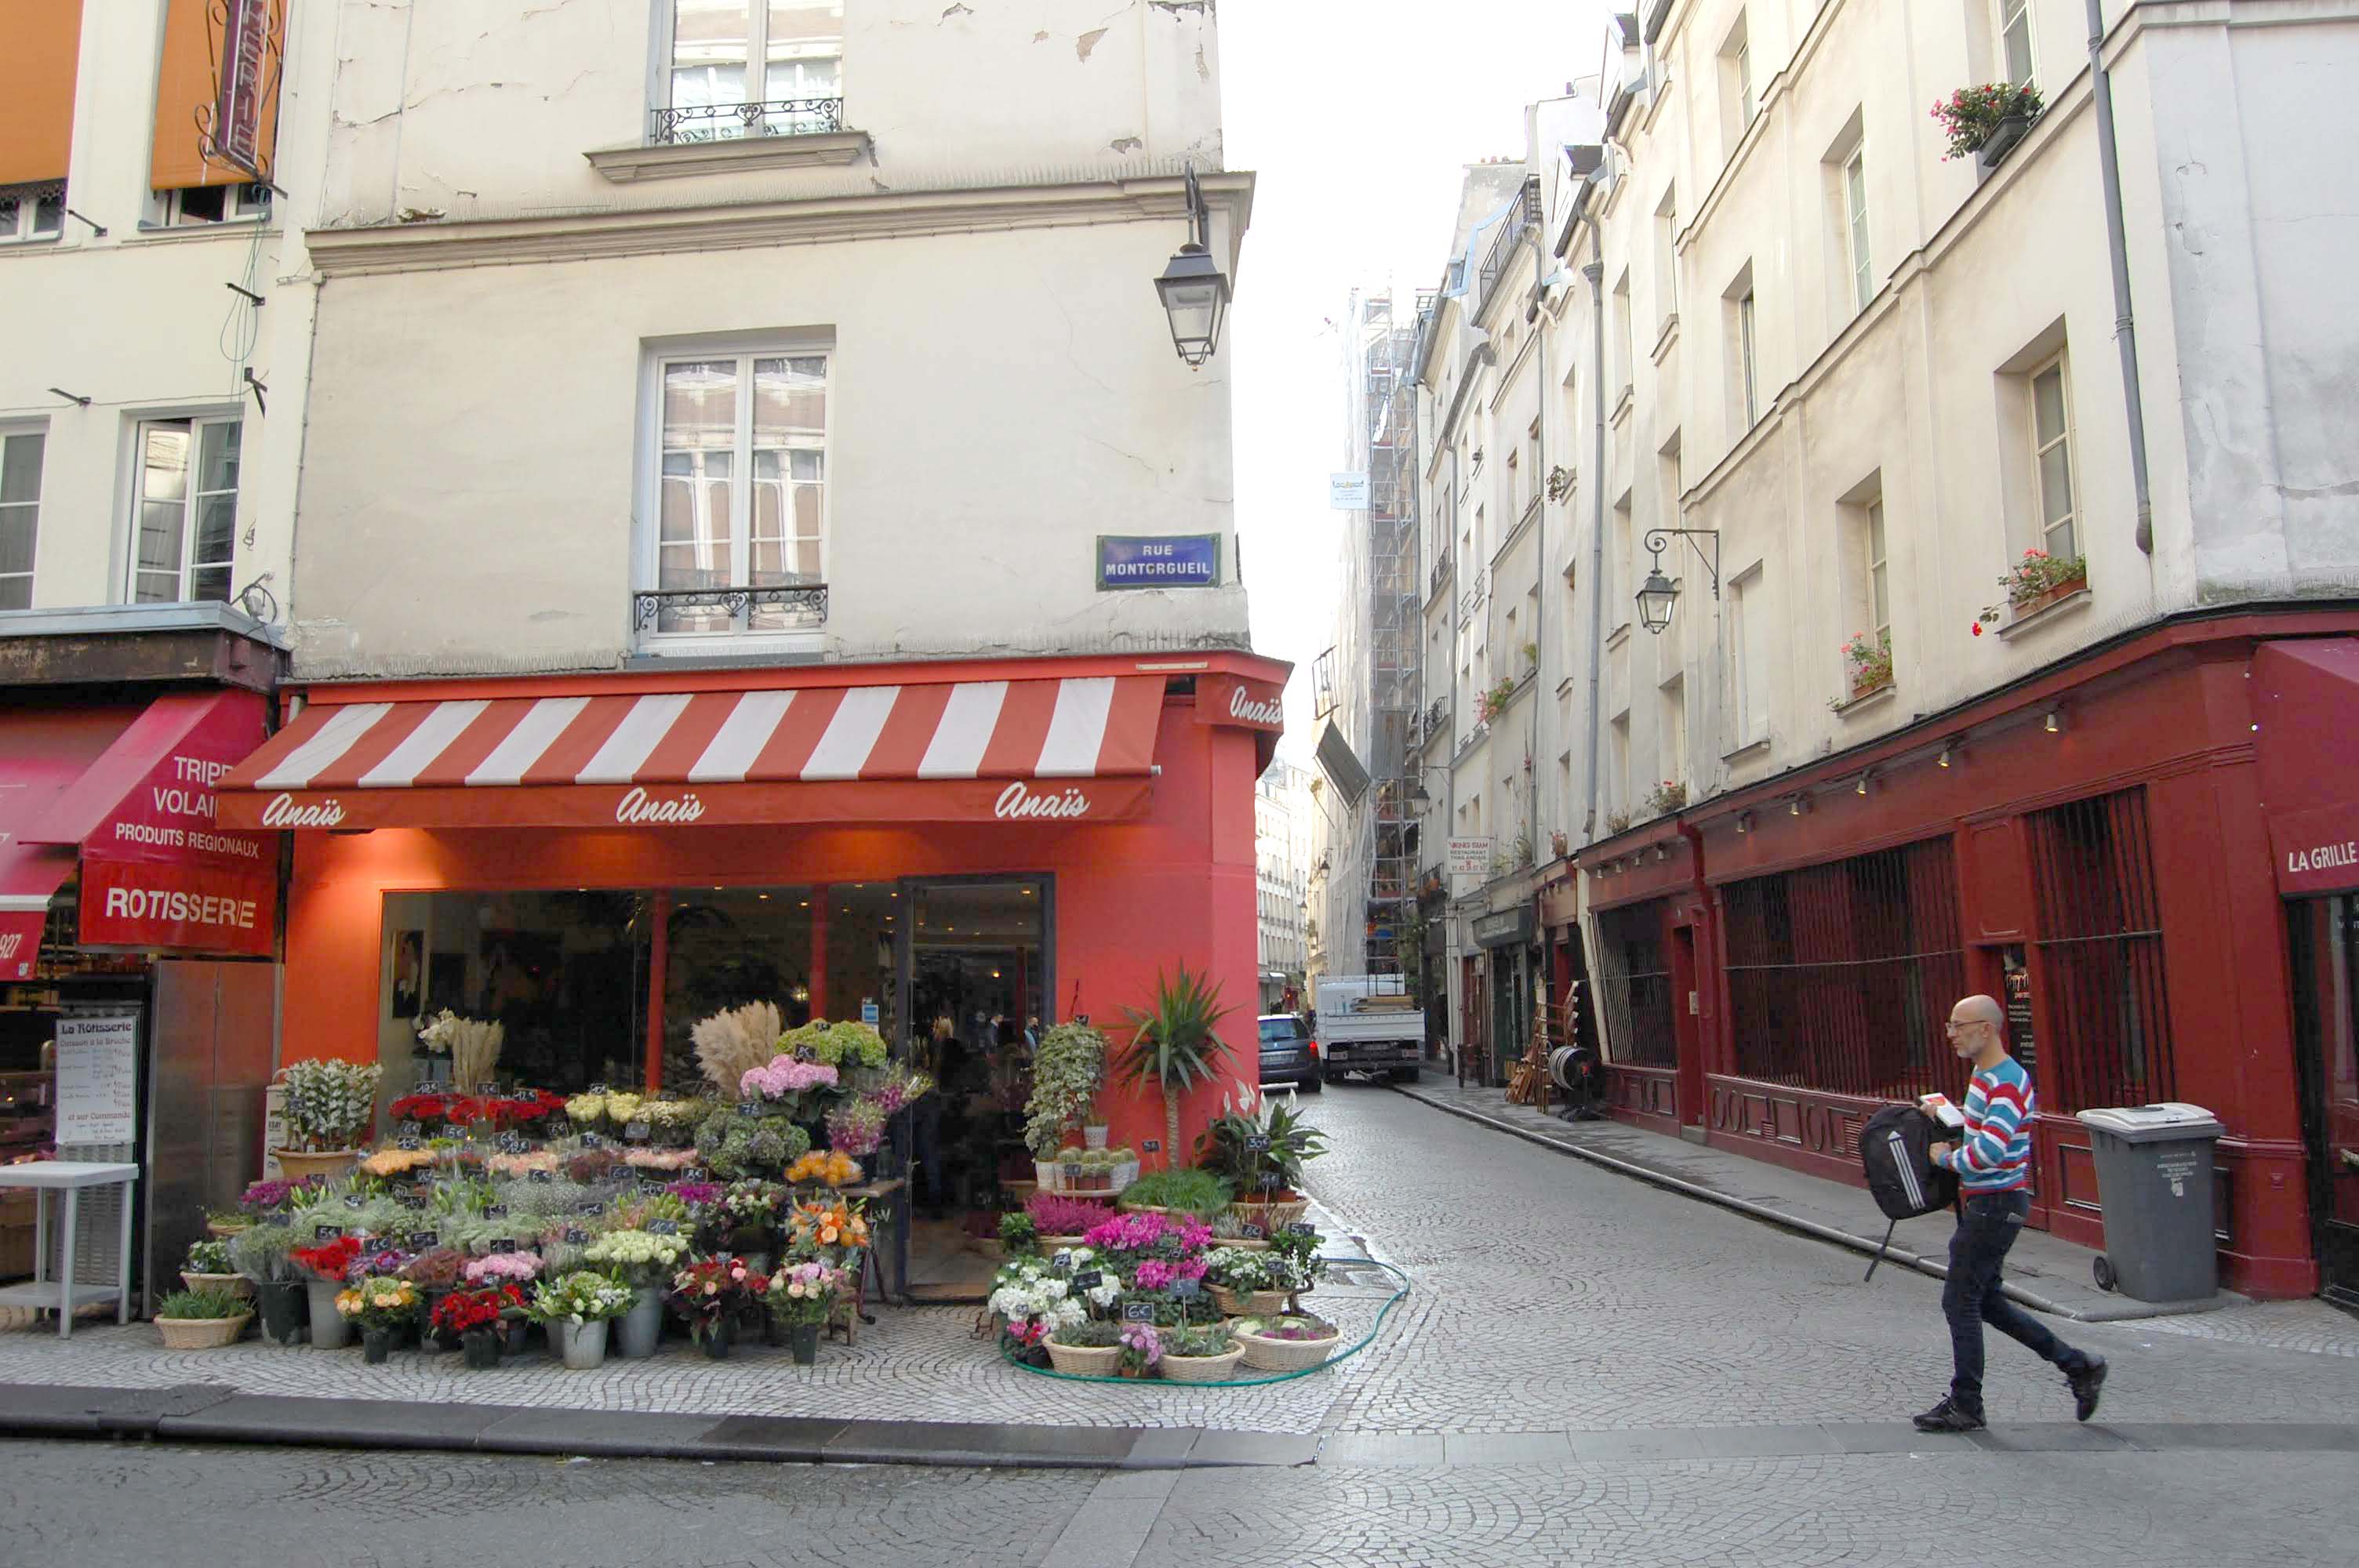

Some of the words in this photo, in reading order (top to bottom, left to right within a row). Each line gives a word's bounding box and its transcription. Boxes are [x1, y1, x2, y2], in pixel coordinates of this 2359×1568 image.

[1143, 545, 1172, 556] RUE
[1106, 562, 1210, 575] MONTORGUEIL
[1230, 685, 1284, 724] Anaïs
[616, 787, 707, 822] Anaïs
[995, 782, 1091, 818] Anaïs
[263, 793, 347, 826] Anaïs
[115, 822, 184, 848] PRODUITS
[188, 831, 259, 859] REGIONAUX
[2288, 851, 2310, 873] LA
[2310, 841, 2357, 869] GRILLE
[106, 887, 256, 928] ROTISSERIE
[62, 1023, 75, 1035] La
[90, 1111, 130, 1120] Commande
[449, 1128, 464, 1137] 5€
[1249, 1137, 1270, 1148] 30€
[686, 1169, 703, 1181] 8€
[319, 1227, 339, 1238] 5€
[568, 1229, 586, 1241] 6€
[1245, 1226, 1259, 1236] 8€
[1128, 1305, 1150, 1319] 6€
